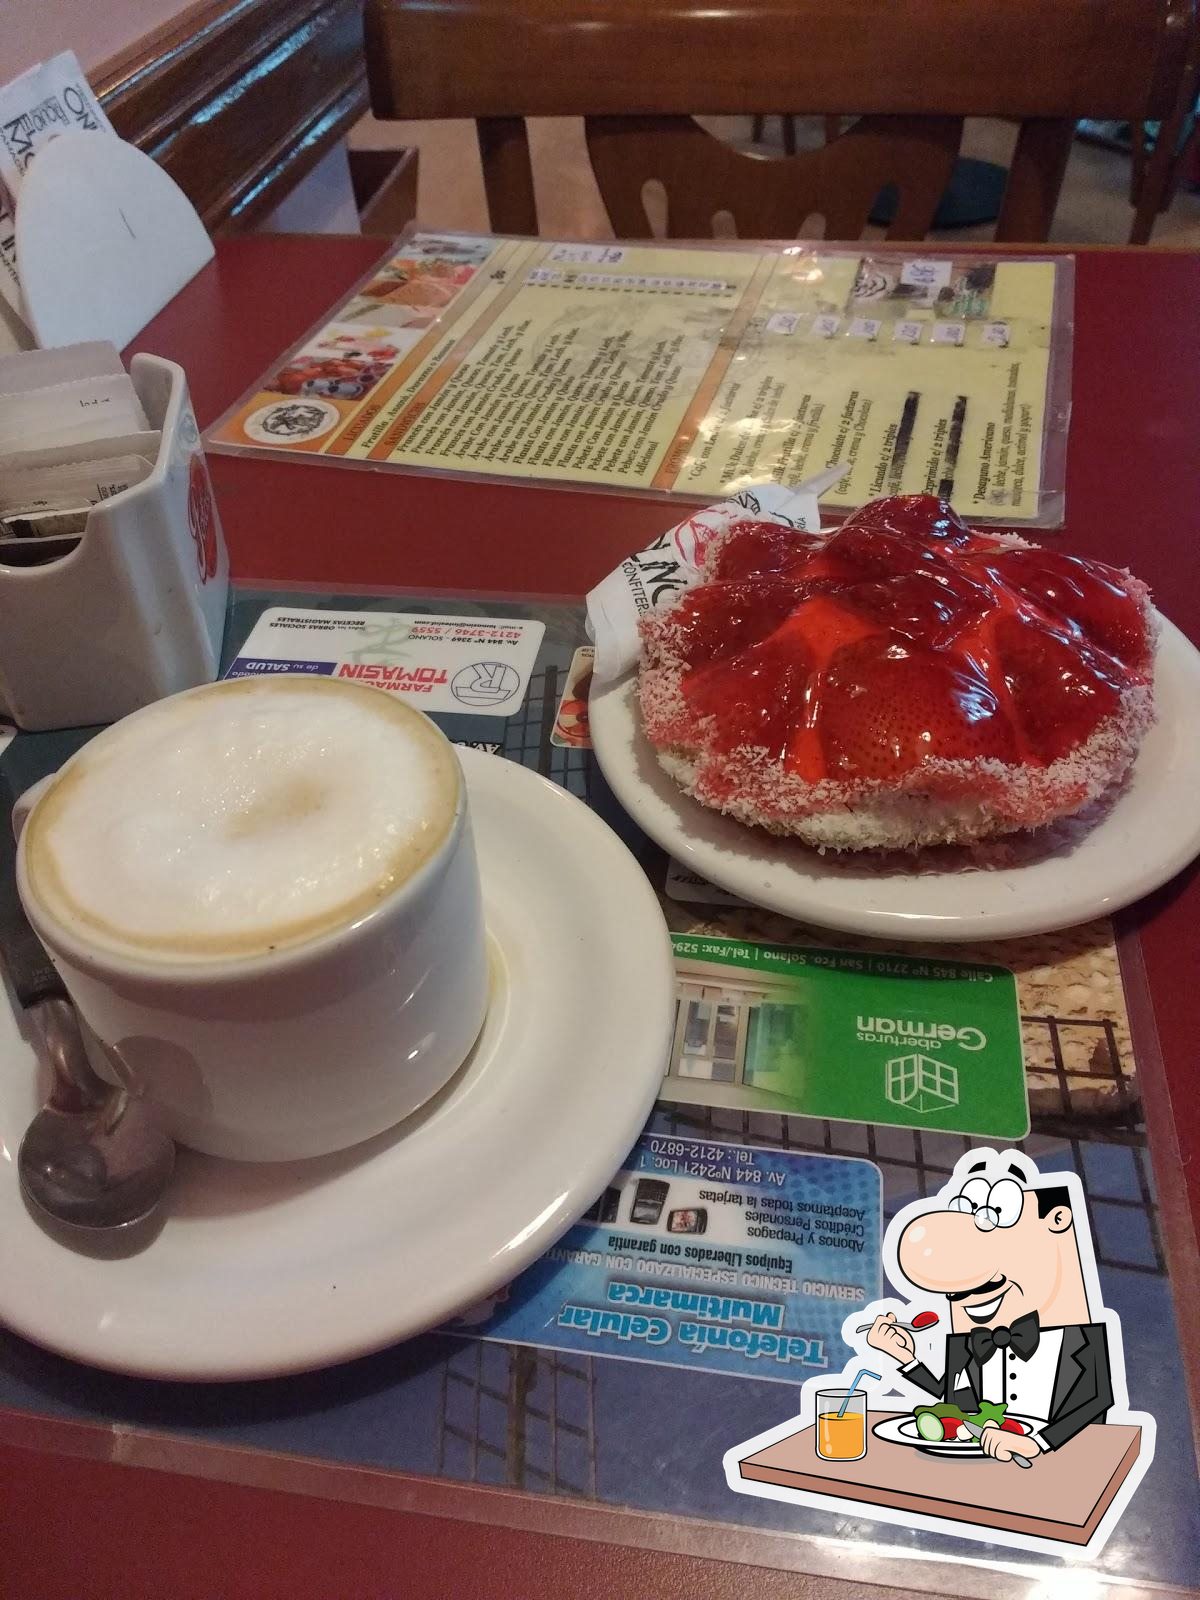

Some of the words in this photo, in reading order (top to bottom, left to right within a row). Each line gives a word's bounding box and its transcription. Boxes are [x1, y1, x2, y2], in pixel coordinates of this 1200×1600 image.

[841, 391, 858, 420] facturas
[980, 422, 994, 461] Americano
[870, 462, 888, 492] Licuado
[973, 462, 990, 499] Desayuno
[622, 561, 651, 616] CONFITER
[268, 621, 307, 629] SOCIALES
[276, 616, 331, 625] MAGISTRALES
[307, 623, 335, 631] OBRAS
[332, 618, 365, 626] RECETAS
[407, 633, 443, 641] SOLANO
[245, 659, 291, 672] SALUD
[305, 664, 318, 672] de
[337, 660, 449, 686] TOMASIN
[701, 942, 750, 959] Tel./Fax:
[763, 949, 806, 966] Solano
[838, 956, 863, 969] San
[877, 960, 908, 974] 2710
[932, 965, 956, 979] 845
[959, 968, 992, 983] Calle
[855, 1013, 986, 1052] German
[855, 1030, 941, 1051] aberturas
[649, 1140, 724, 1161] 4212-6870
[726, 1148, 756, 1165] Tel.:
[649, 1155, 678, 1171] Loc.
[735, 1167, 762, 1181] 844
[764, 1170, 785, 1184] Av.
[698, 1187, 743, 1206] tarjetas
[745, 1195, 757, 1208] la
[759, 1196, 794, 1213] todas
[796, 1199, 866, 1220] Aceptamos
[744, 1210, 811, 1230] Personales
[813, 1218, 864, 1236] Créditos
[747, 1223, 804, 1245] Prepagos
[818, 1234, 864, 1252] Abonos
[606, 1234, 657, 1254] garantía
[659, 1241, 681, 1256] con
[605, 1254, 633, 1270] CON
[683, 1244, 742, 1266] Liberados
[745, 1252, 792, 1273] Equipos
[635, 1258, 737, 1285] ESPECIALIZADO
[741, 1271, 800, 1296] TÉCNICO
[802, 1279, 865, 1302] SERVICIO
[605, 1281, 783, 1329] Multimarca
[556, 1304, 672, 1345] Celular
[675, 1321, 828, 1368] Telefonía
